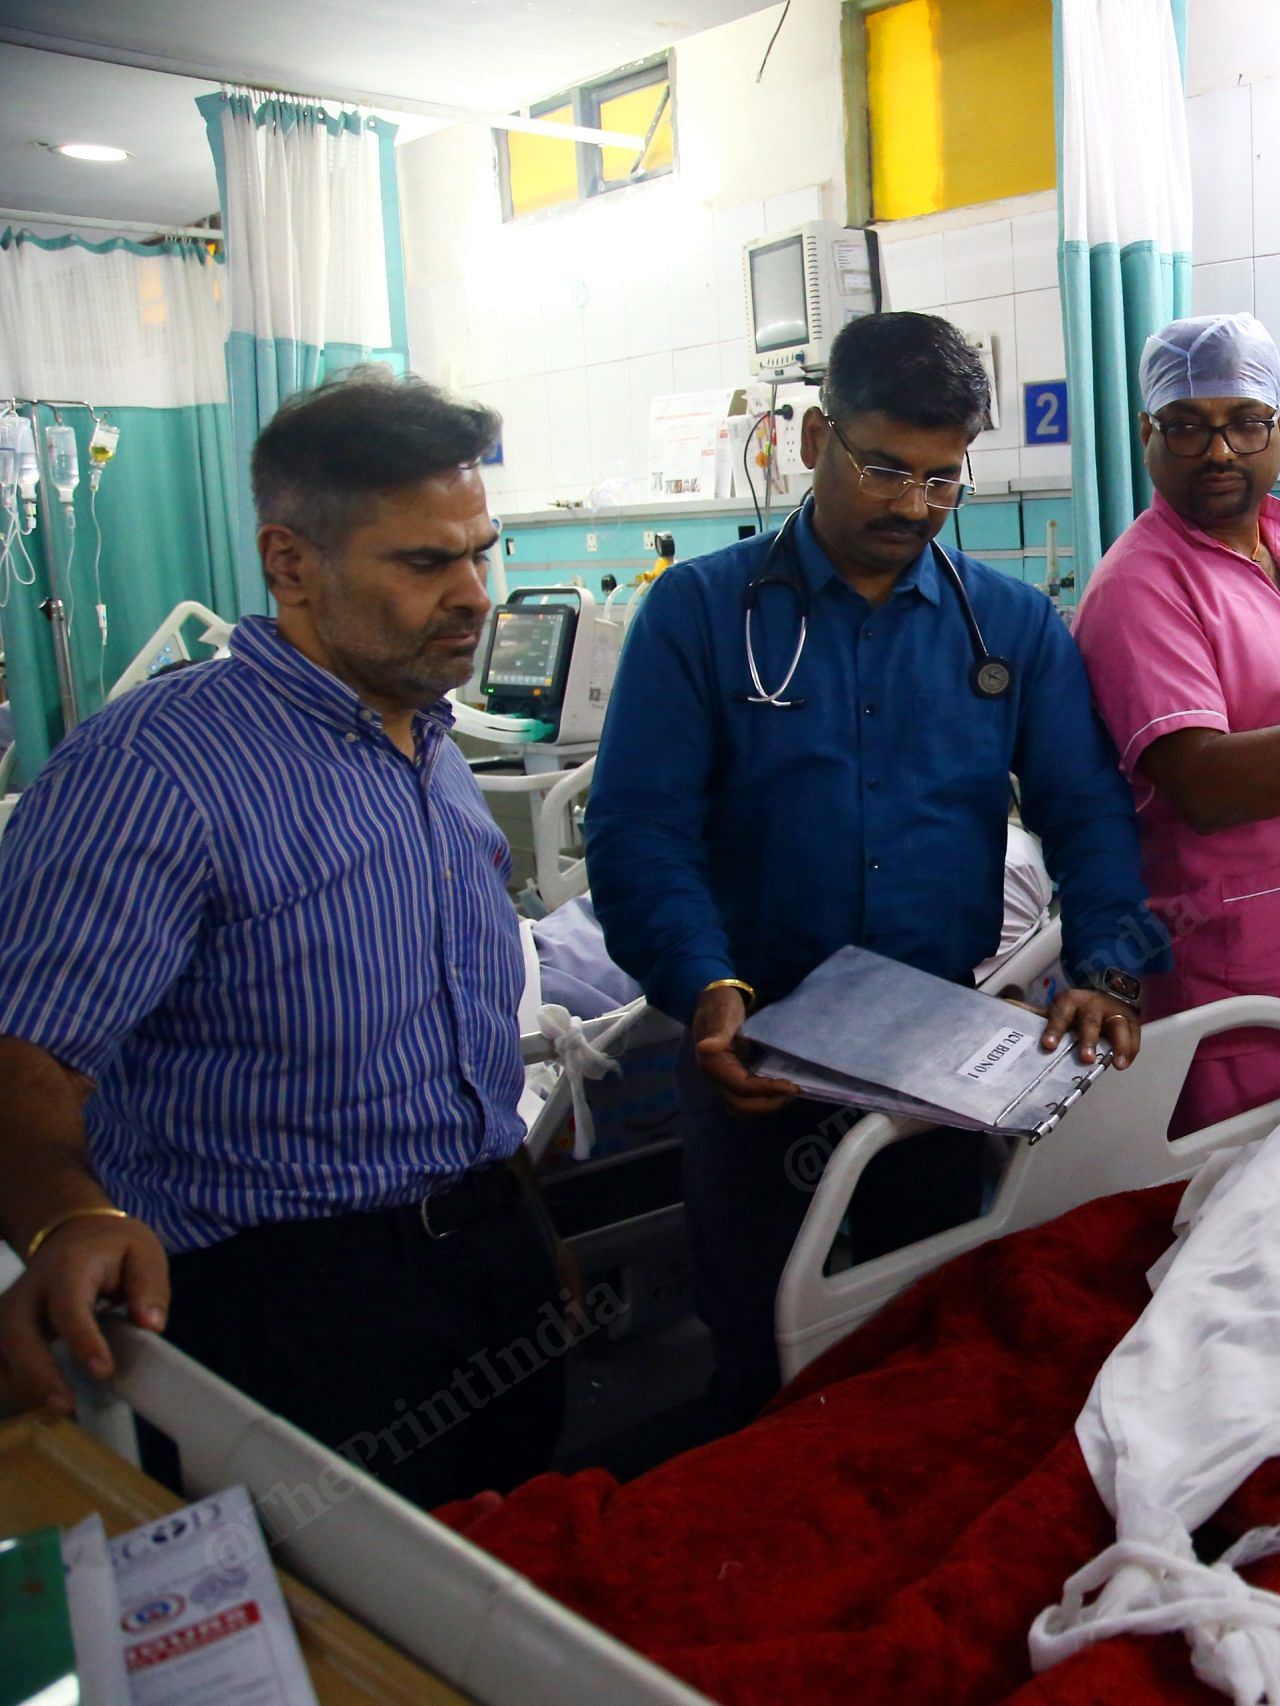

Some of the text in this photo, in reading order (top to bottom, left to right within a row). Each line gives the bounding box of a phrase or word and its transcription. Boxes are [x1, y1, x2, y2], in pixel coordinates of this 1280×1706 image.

[1036, 393, 1059, 435] 2
[1003, 1031, 1024, 1046] ICU
[987, 1044, 1010, 1061] BED
[974, 1061, 994, 1073] NO
